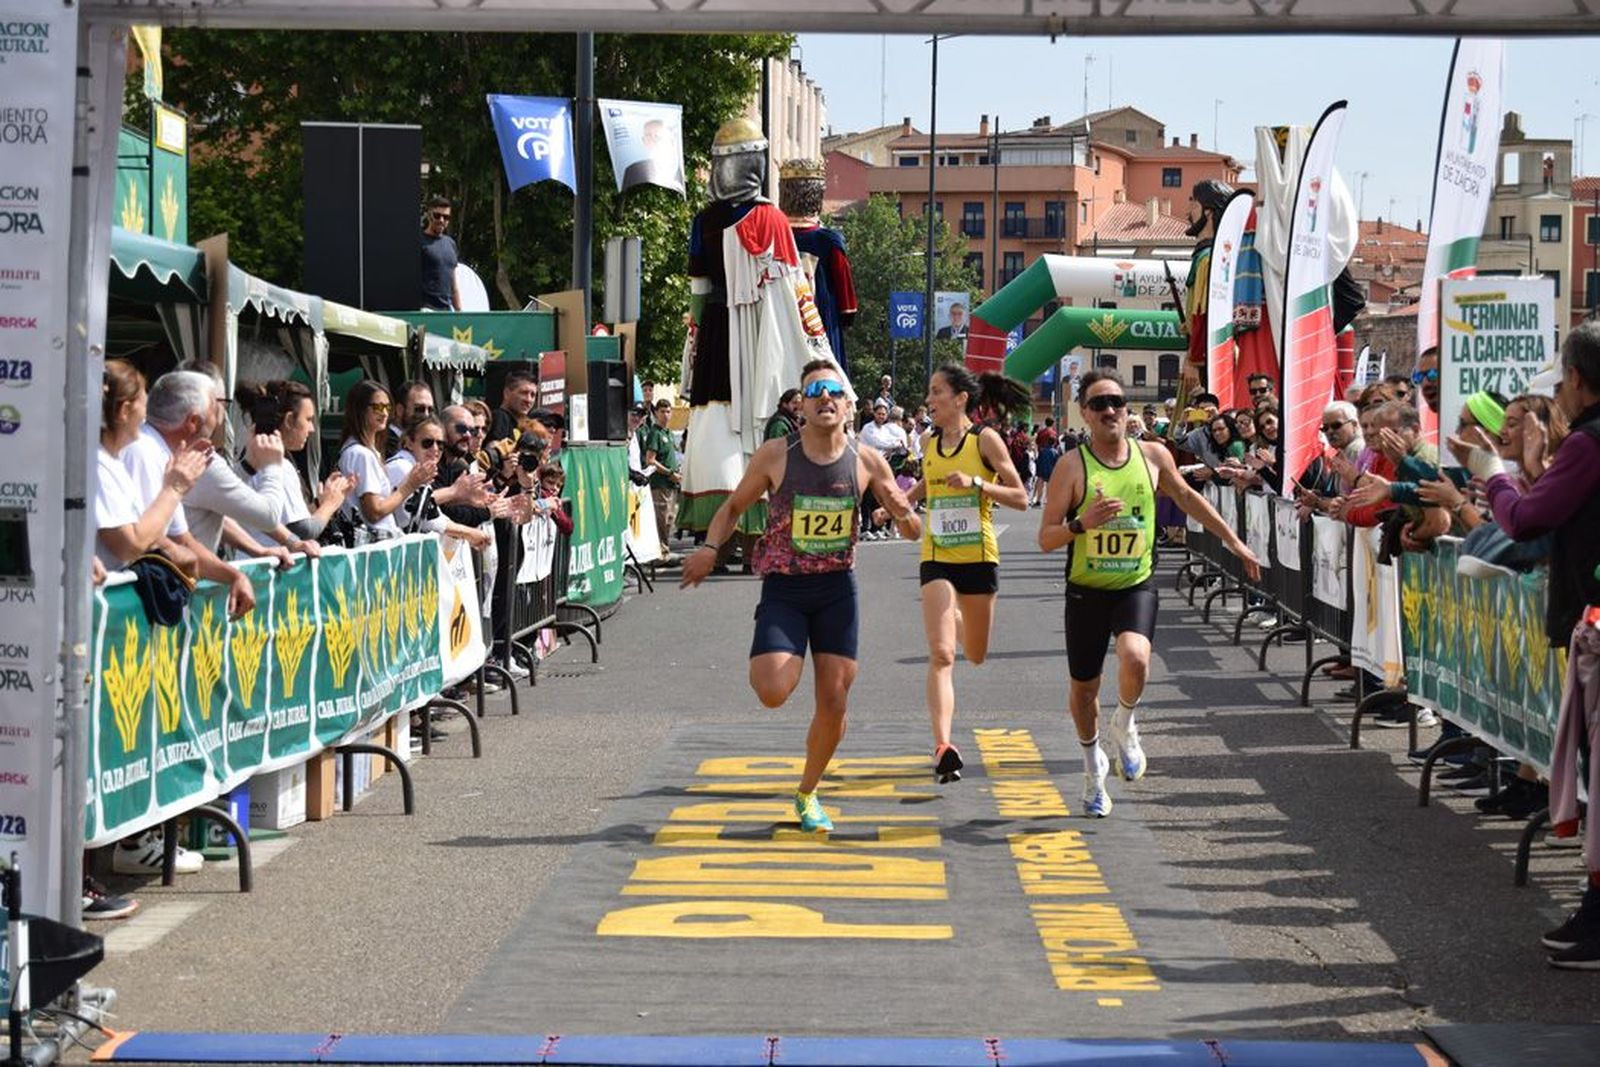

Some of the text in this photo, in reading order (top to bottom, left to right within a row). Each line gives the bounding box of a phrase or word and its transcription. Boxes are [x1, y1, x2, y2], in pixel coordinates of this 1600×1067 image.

[0, 39, 49, 53] URAL
[0, 108, 48, 124] IENTO
[0, 124, 48, 144] ORA
[1138, 285, 1156, 296] DE
[897, 304, 918, 312] VOTA
[1459, 302, 1539, 330] TERMINAR
[1131, 320, 1179, 338] CAJA
[1452, 334, 1546, 362] LA CARRERA
[1459, 367, 1479, 394] EN
[800, 513, 843, 536] 124
[1093, 532, 1138, 555] 107
[0, 814, 26, 835] za
